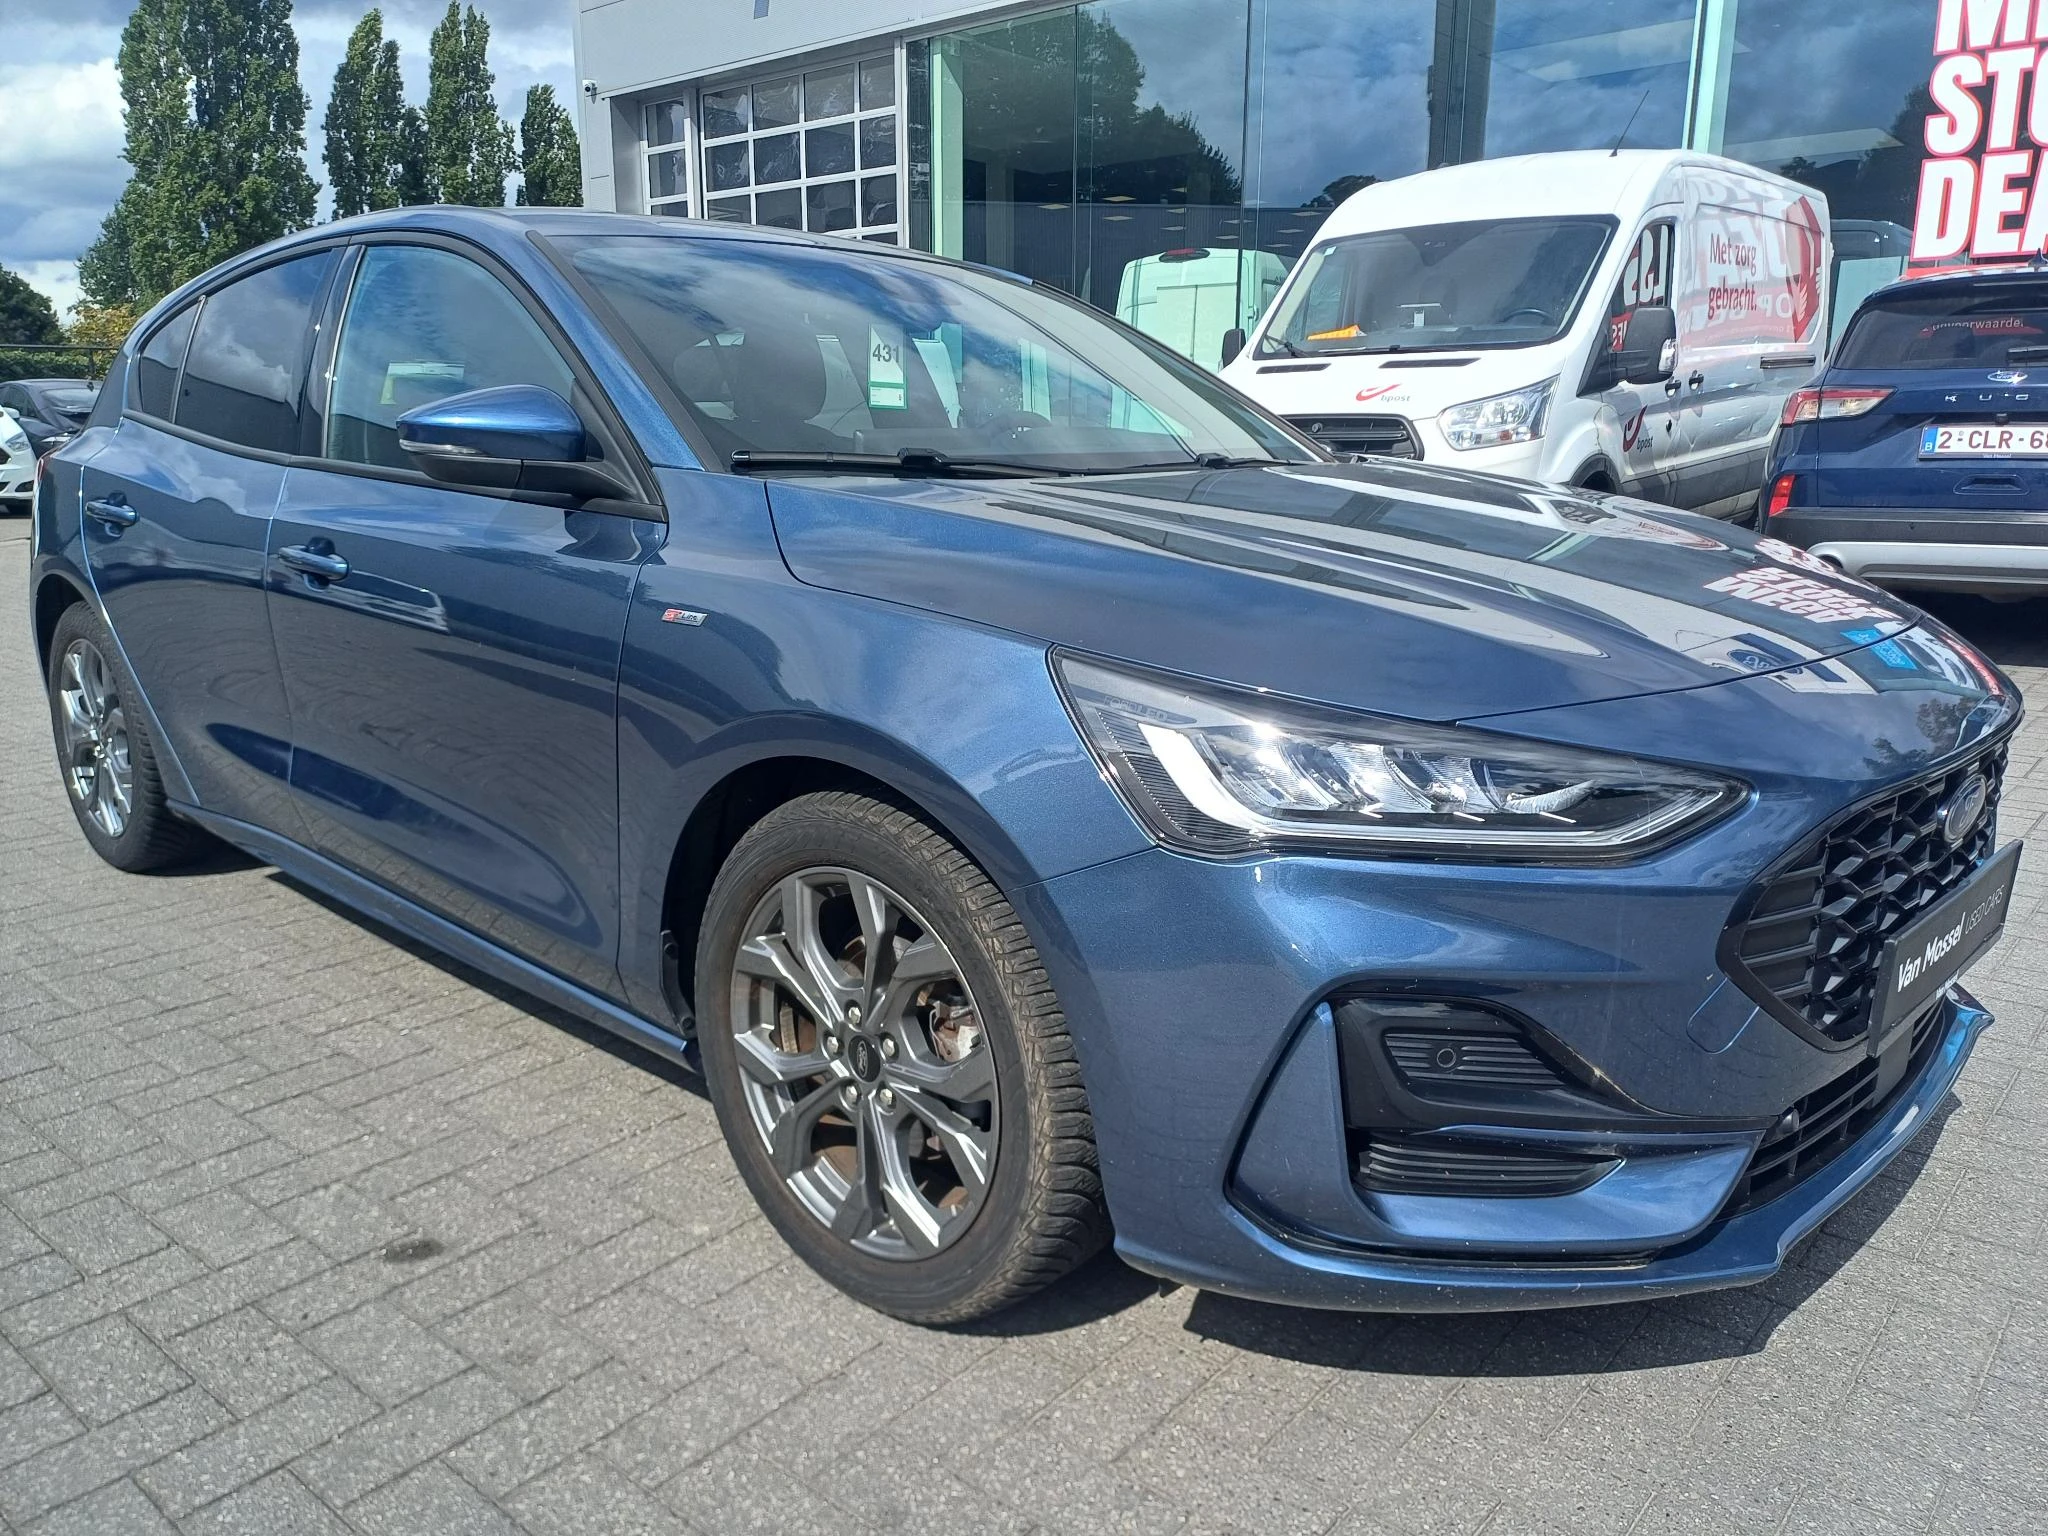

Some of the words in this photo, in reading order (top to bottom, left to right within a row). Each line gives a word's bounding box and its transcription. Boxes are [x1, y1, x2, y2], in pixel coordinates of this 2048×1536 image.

[1709, 233, 1733, 264] Met
[1735, 243, 1757, 277] zorg
[1707, 277, 1757, 320] gebracht.
[872, 343, 900, 363] 431
[1380, 394, 1411, 403] bpost
[1636, 436, 1654, 453] bpost
[1897, 956, 1922, 993] Van
[1921, 911, 1966, 973] Mossel
